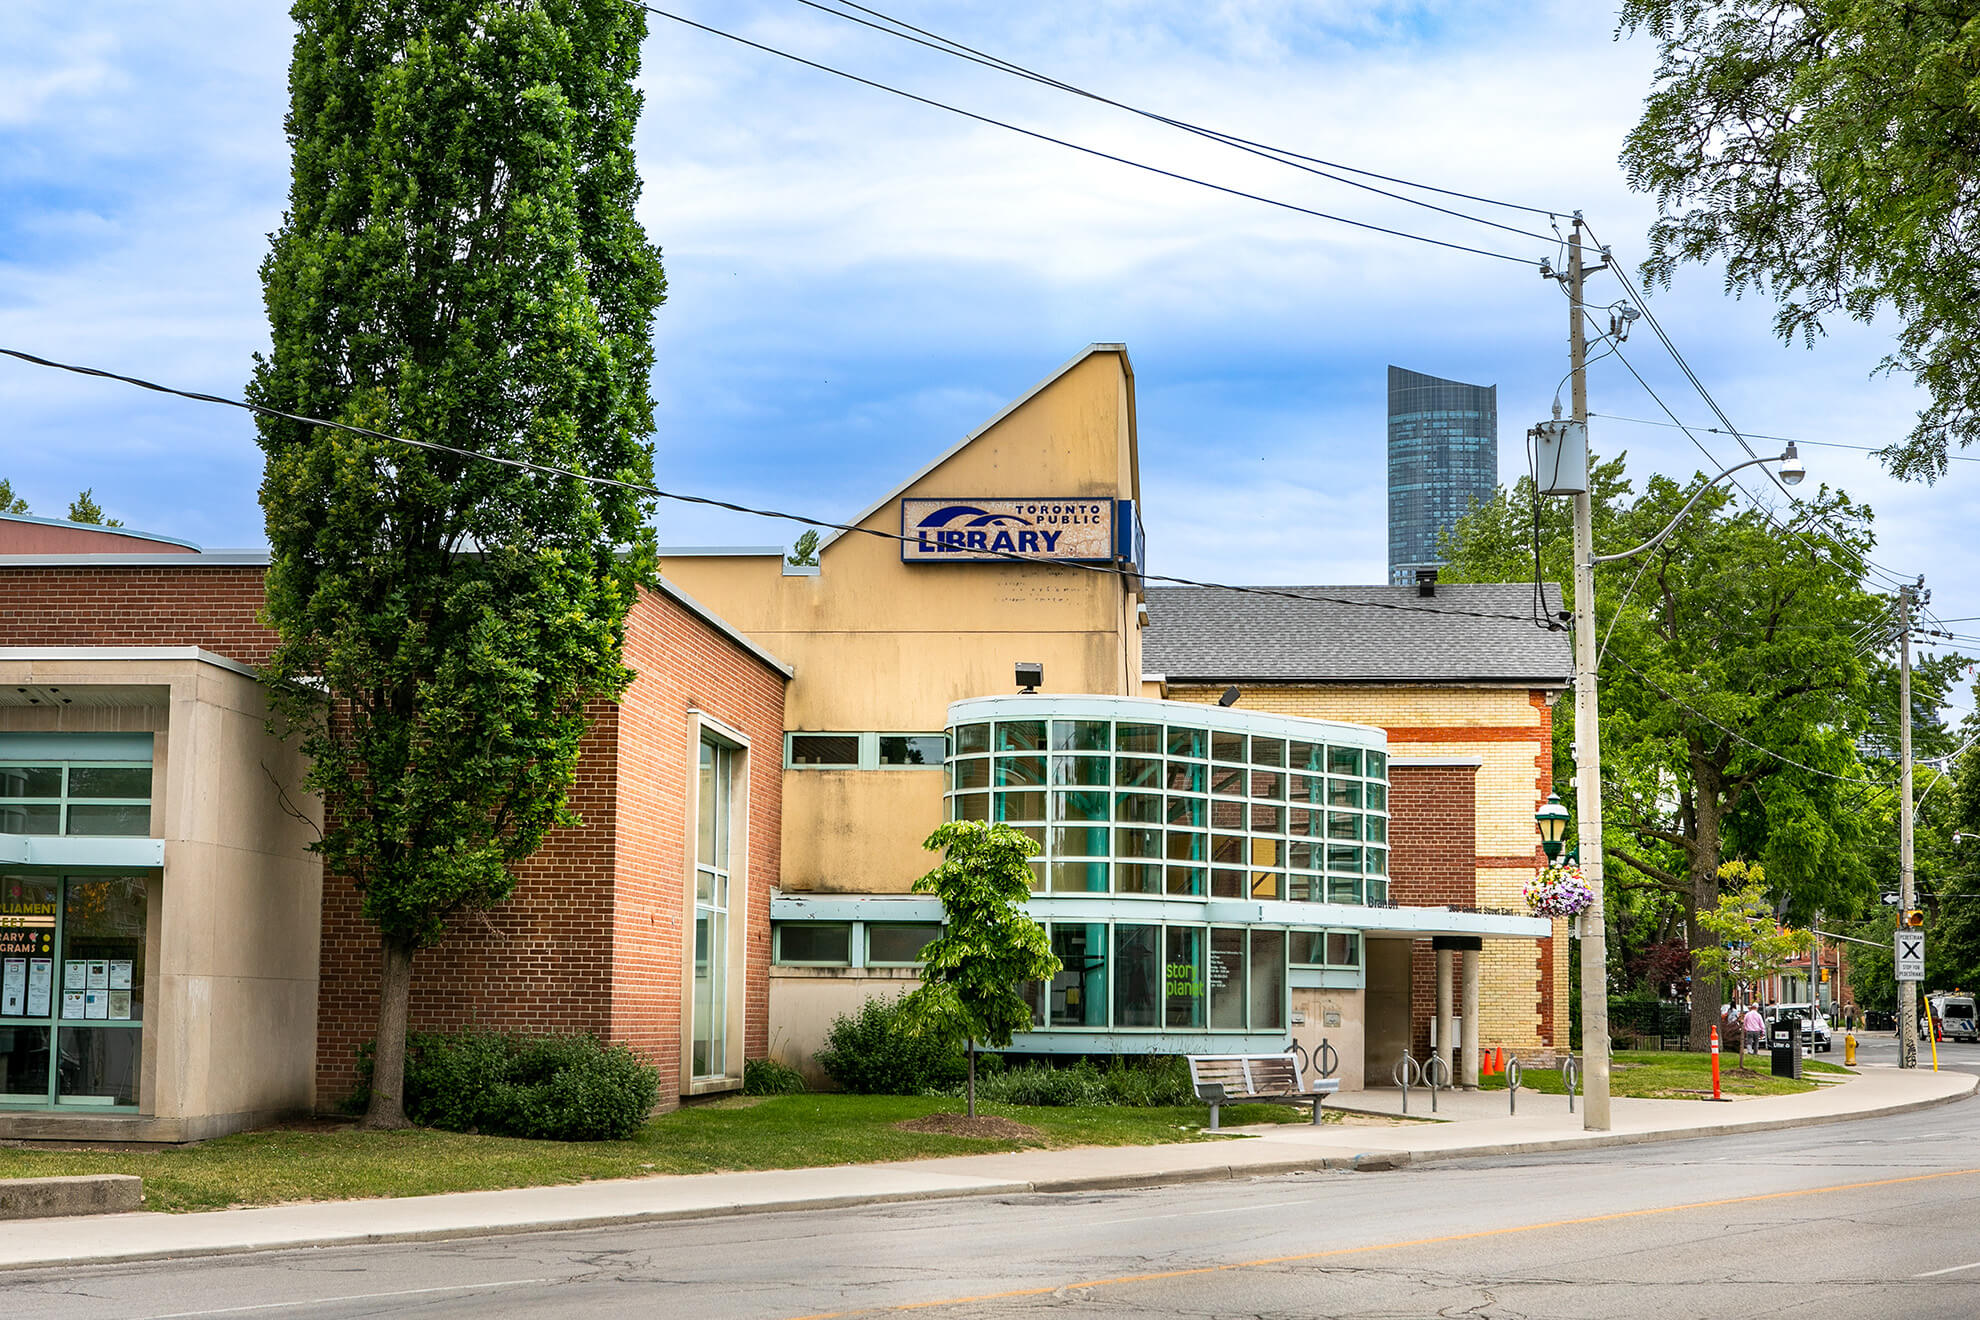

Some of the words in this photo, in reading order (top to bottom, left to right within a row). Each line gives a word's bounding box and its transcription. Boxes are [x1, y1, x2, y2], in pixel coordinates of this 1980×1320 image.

[1016, 505, 1100, 514] TORONTO
[1036, 516, 1100, 524] PUBLIC
[918, 530, 1063, 552] LIBRARY
[0, 904, 56, 914] LIAMENT
[0, 932, 24, 941] ARY
[1166, 962, 1198, 982] story
[1166, 980, 1204, 999] planet
